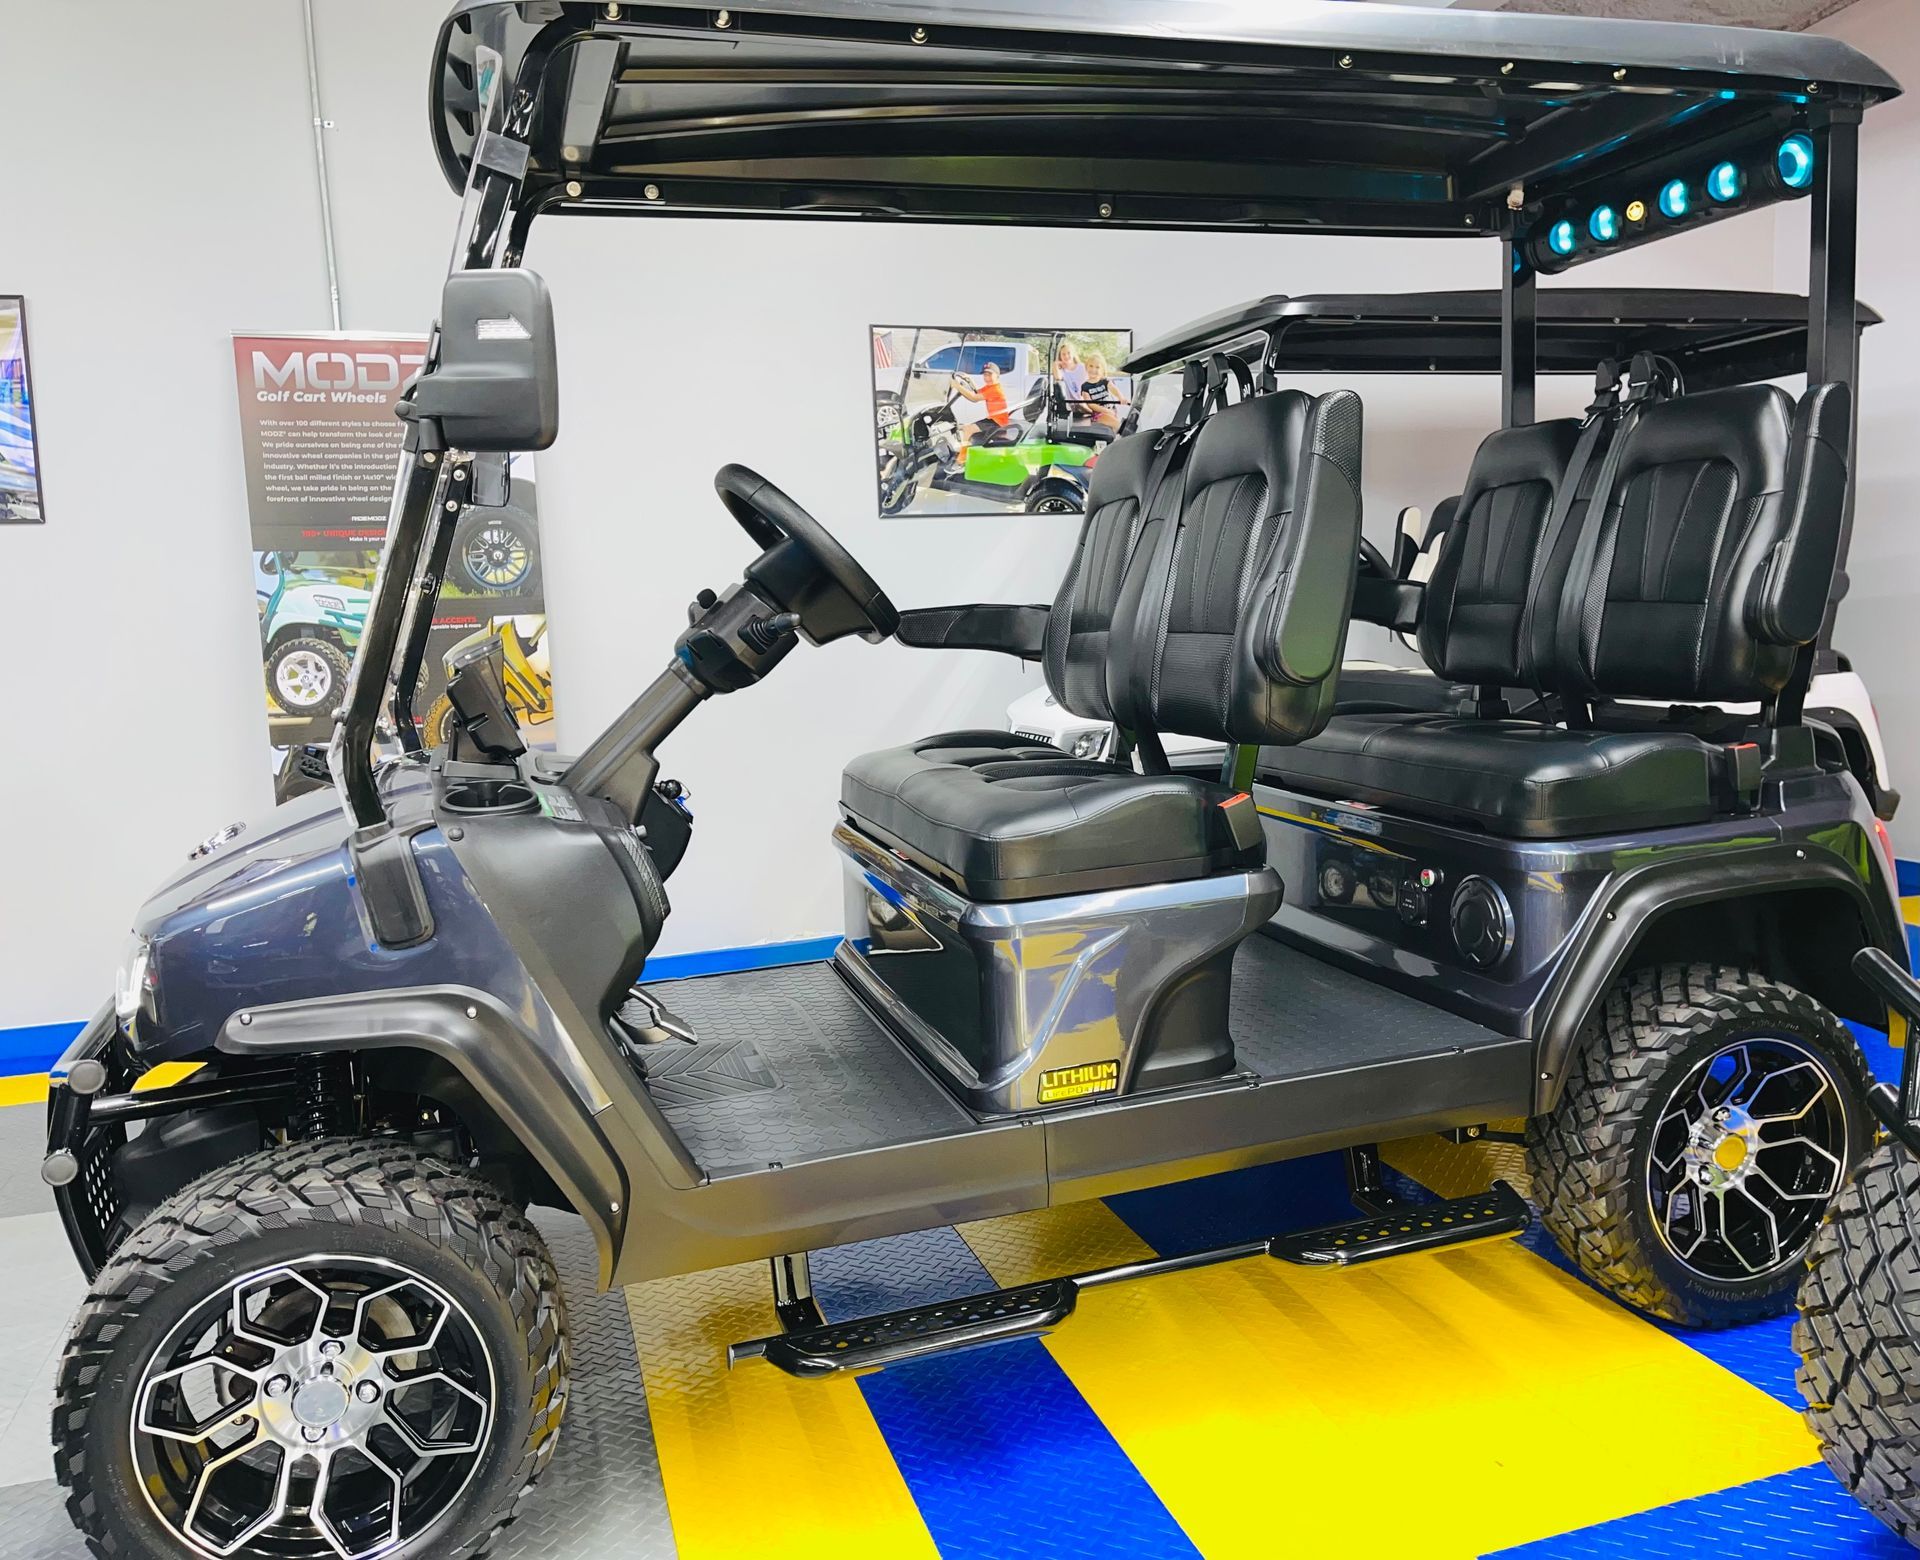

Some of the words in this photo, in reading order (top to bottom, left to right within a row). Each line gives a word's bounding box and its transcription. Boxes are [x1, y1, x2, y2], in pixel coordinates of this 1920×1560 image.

[256, 390, 289, 402] Golf
[293, 391, 326, 402] Cart
[331, 392, 387, 403] Wheels
[1042, 1062, 1117, 1088] LITHIUM
